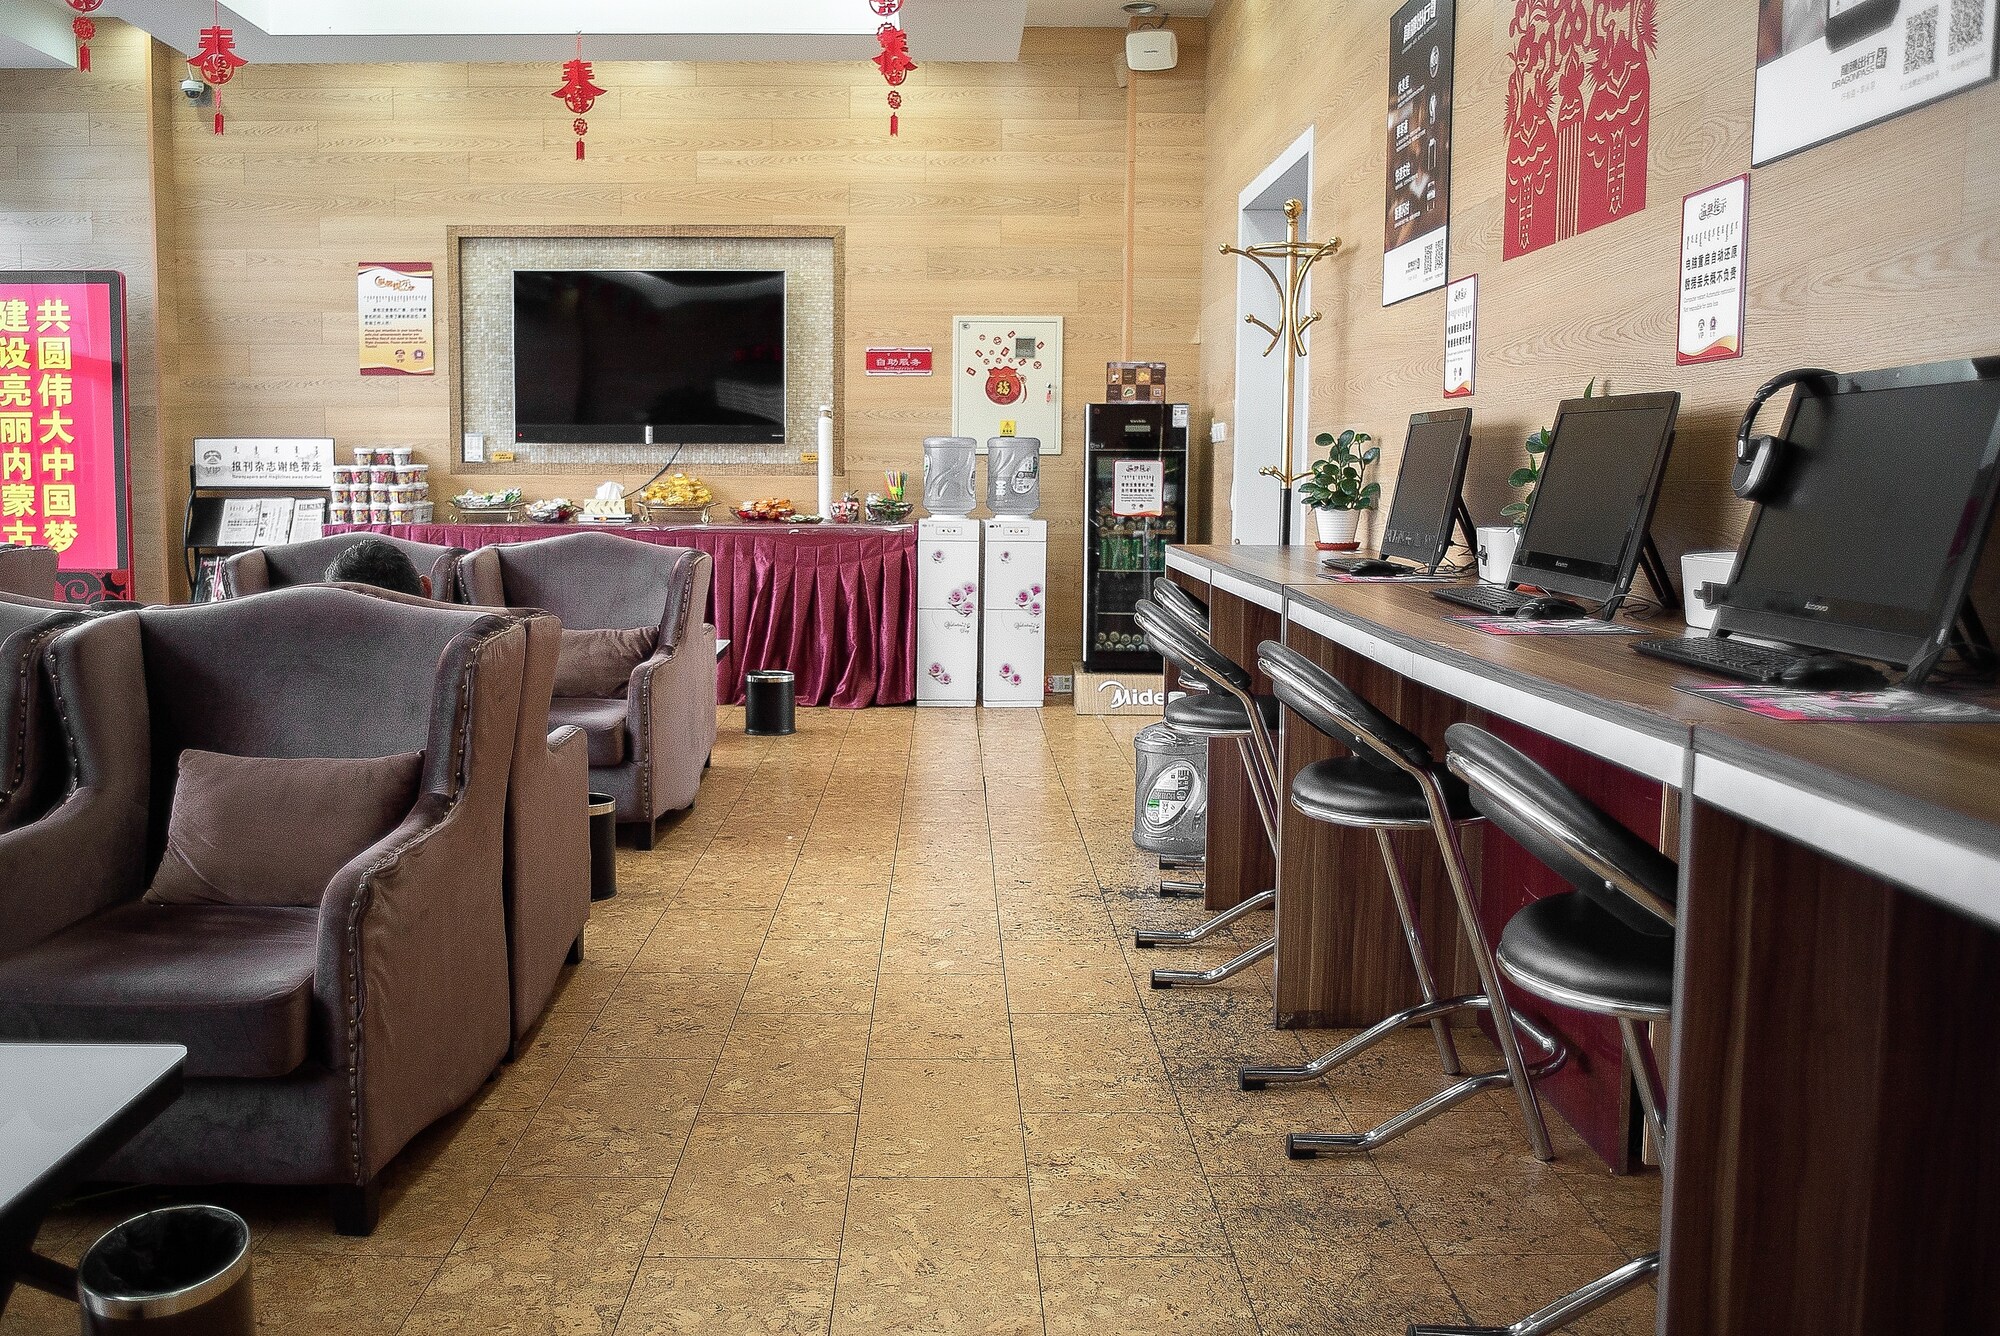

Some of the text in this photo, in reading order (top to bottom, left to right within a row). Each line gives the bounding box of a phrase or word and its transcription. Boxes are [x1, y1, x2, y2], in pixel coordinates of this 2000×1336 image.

[1831, 65, 1875, 90] DRAGONPASS
[1685, 244, 1738, 271] 电脑重启自动还原
[876, 358, 921, 367] 自助服务
[0, 299, 36, 547] 建设亮丽内蒙古
[36, 299, 78, 554] 共圆伟大中国梦
[231, 461, 322, 472] 报刊杂志谢绝带走
[1110, 688, 1164, 709] Mide
